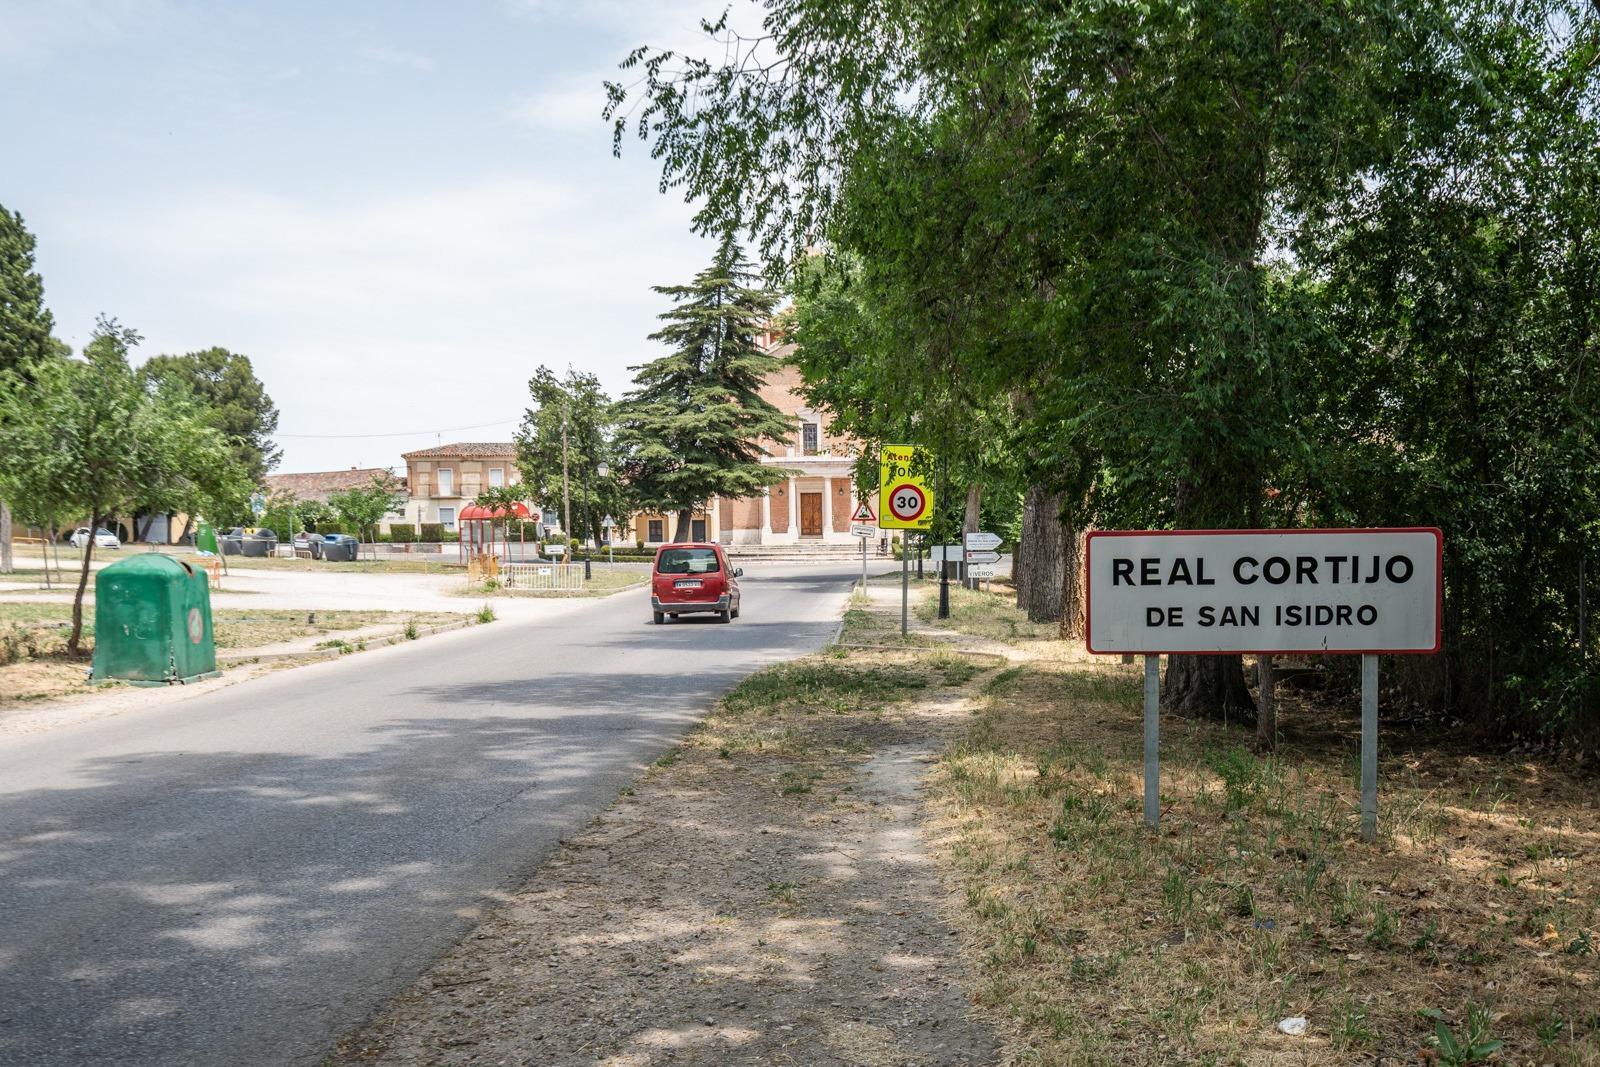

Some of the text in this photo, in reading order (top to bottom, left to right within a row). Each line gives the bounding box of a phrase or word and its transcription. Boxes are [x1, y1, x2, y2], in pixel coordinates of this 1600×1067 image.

[897, 496, 918, 509] 30
[1112, 555, 1414, 586] REAL CORTIJO
[1146, 604, 1378, 627] DE SAN ISIDRO
